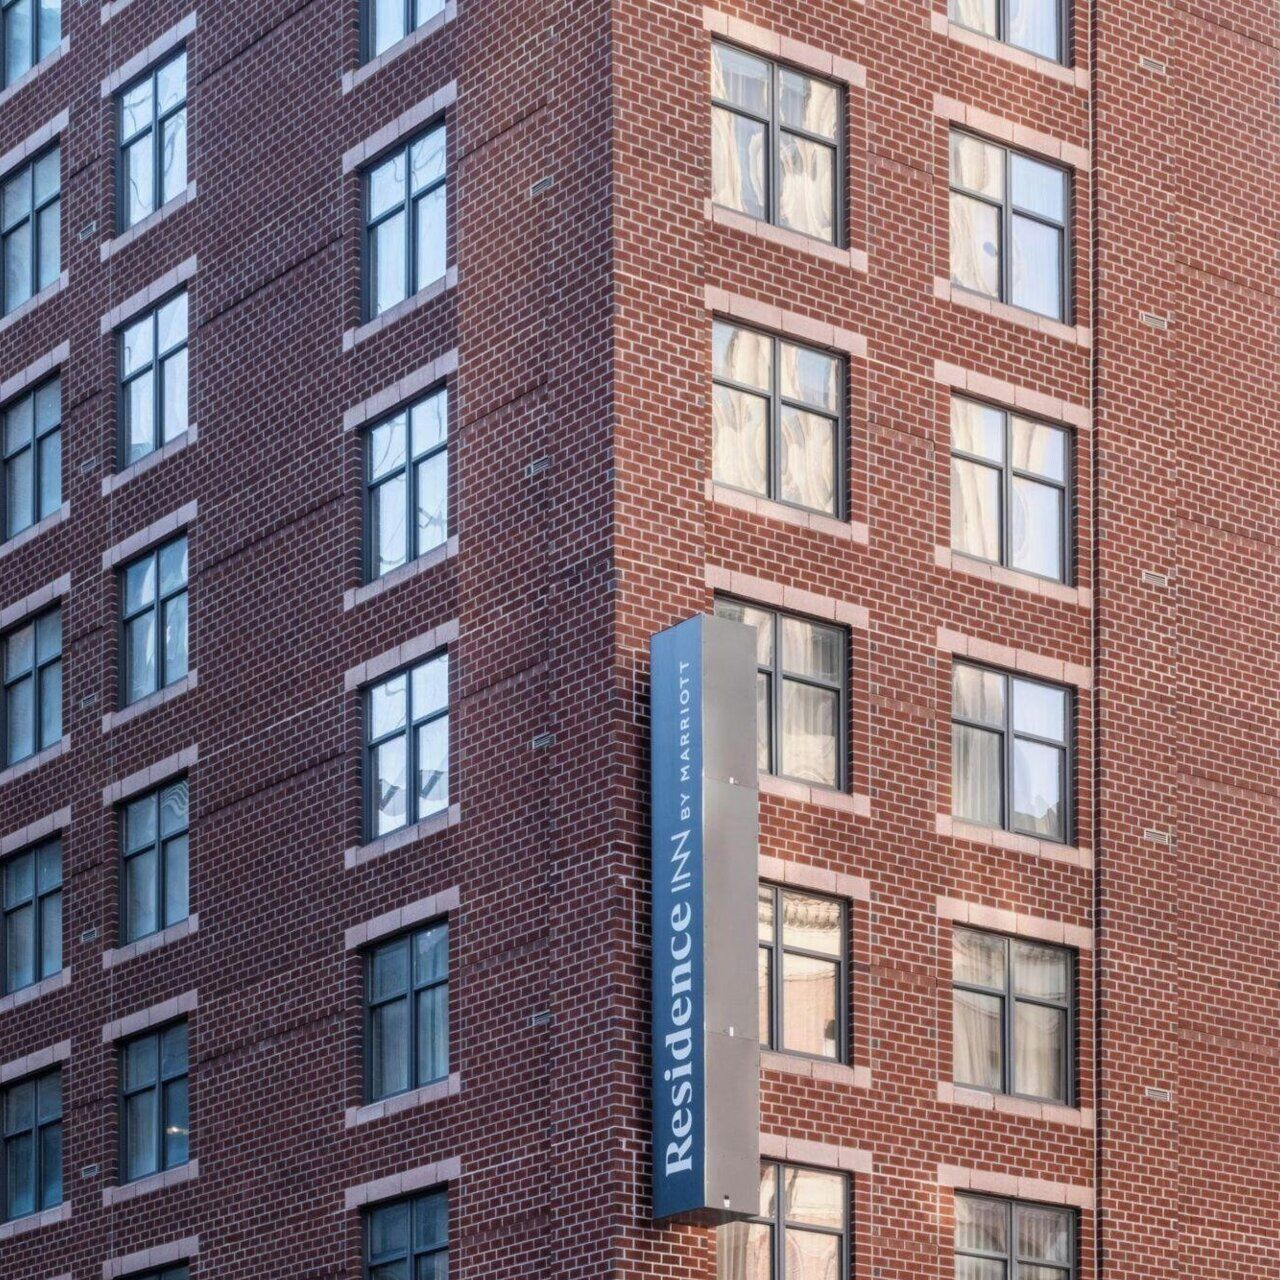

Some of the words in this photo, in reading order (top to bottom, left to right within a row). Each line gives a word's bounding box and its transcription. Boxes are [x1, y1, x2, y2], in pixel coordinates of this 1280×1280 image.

[679, 661, 690, 783] MARRIOTT
[680, 793, 691, 821] BY
[670, 828, 692, 894] INN
[664, 900, 694, 1178] Residence
